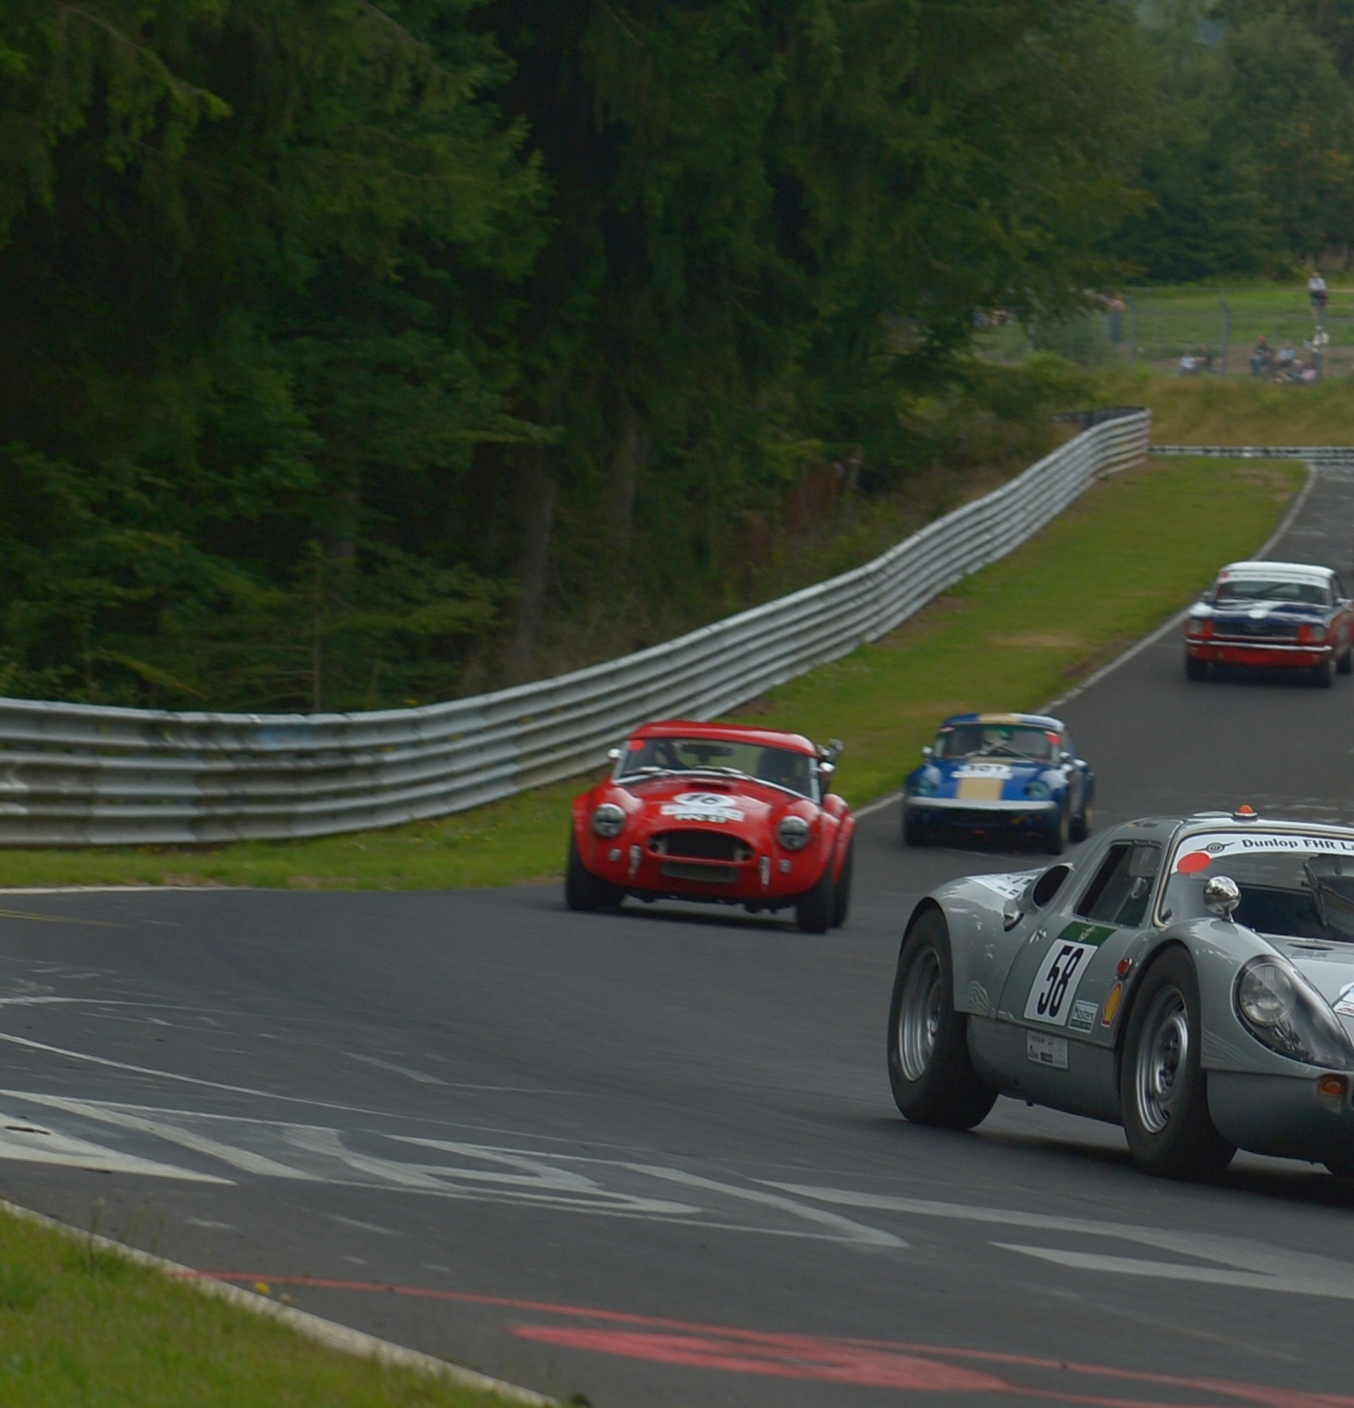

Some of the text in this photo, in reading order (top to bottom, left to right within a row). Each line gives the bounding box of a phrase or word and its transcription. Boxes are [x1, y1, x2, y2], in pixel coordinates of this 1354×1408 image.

[1241, 839, 1298, 849] Dunlop
[1303, 840, 1336, 850] FHR
[1037, 945, 1085, 1018] 58
